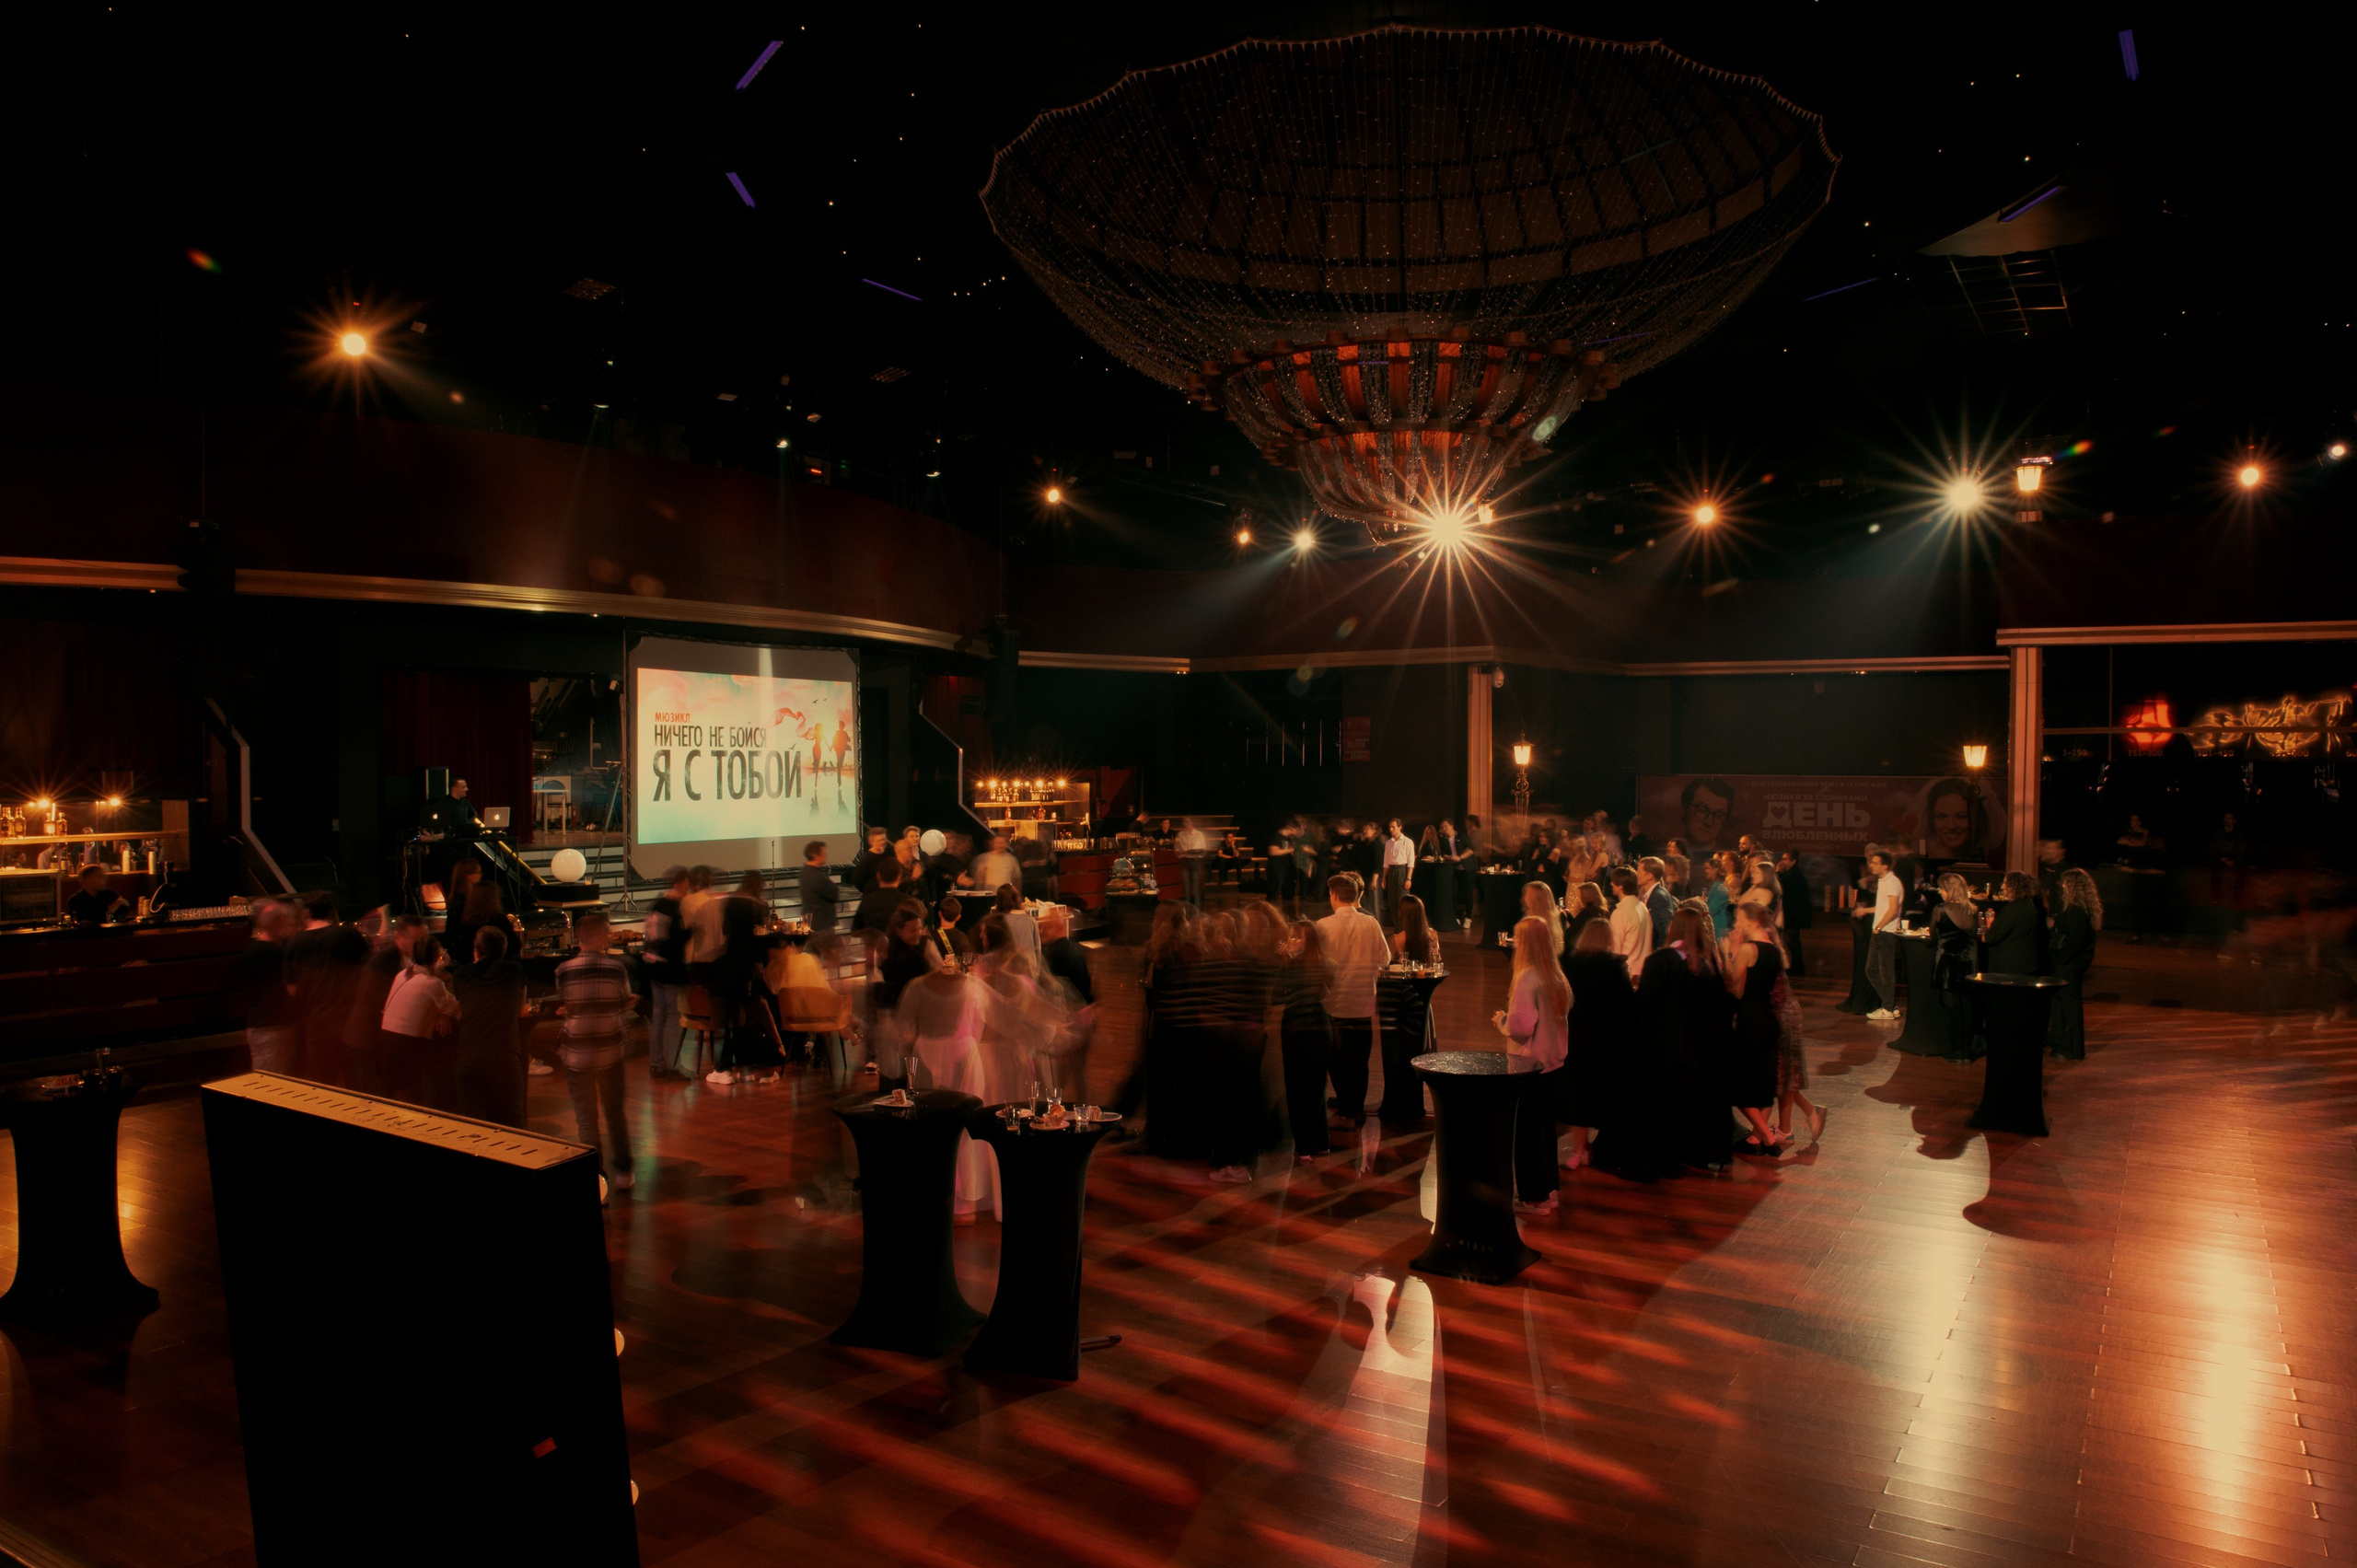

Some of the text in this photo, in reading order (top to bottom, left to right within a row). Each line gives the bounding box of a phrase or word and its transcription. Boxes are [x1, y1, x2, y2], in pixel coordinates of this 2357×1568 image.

[655, 712, 691, 723] МЮЗИКЛ
[654, 725, 702, 748] НИЧЕГО
[709, 726, 724, 748] НЕ
[2062, 749, 2087, 757] 1-150
[653, 749, 671, 801] Я
[684, 749, 702, 801] С
[1762, 801, 1871, 829] ДЕНЬ
[1762, 830, 1868, 842] ВЛЮБЛЕННЫХ
